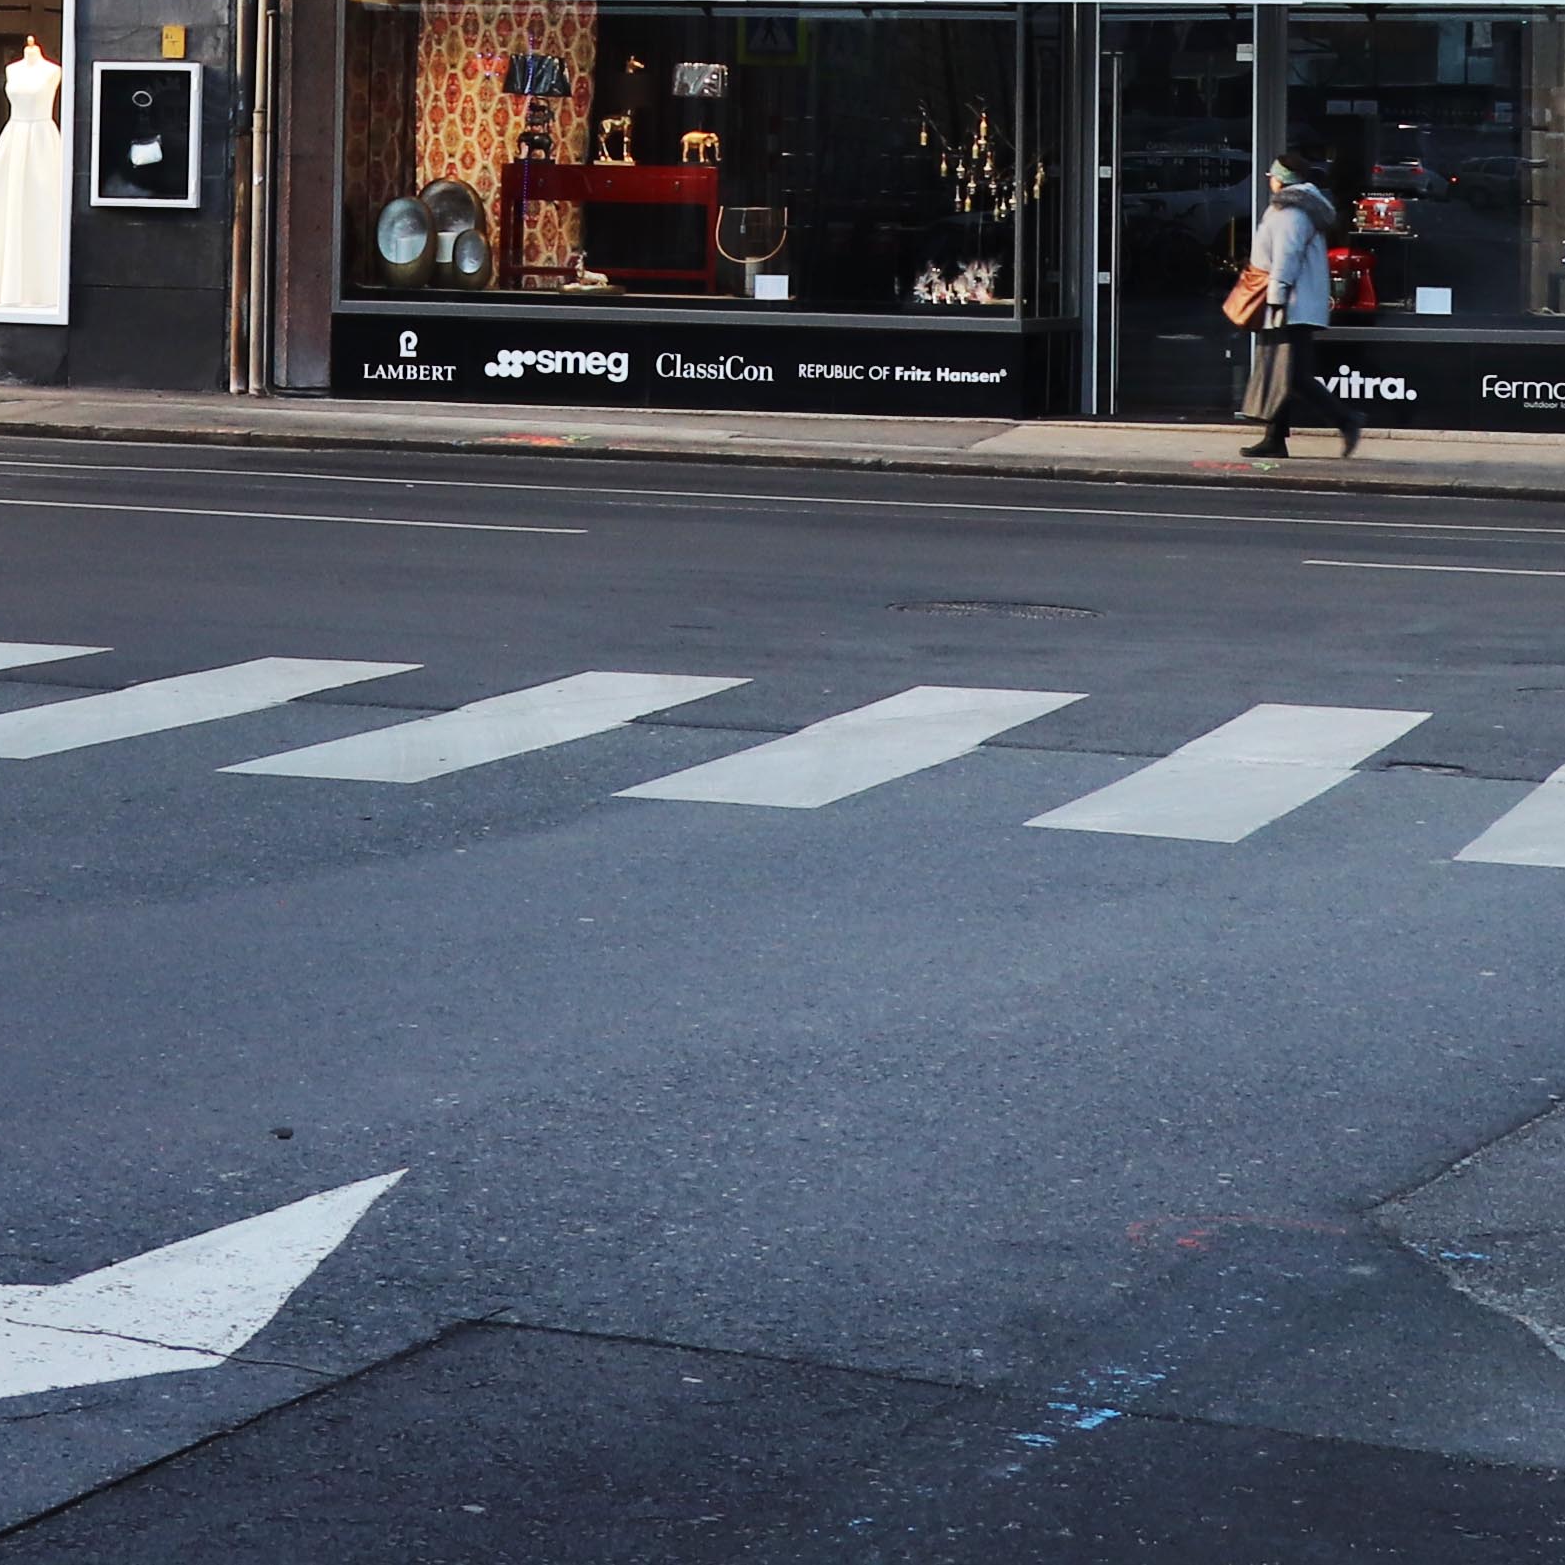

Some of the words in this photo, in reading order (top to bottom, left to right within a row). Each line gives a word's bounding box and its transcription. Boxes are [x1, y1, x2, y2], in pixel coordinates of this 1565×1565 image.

[364, 363, 457, 381] LAMBERT
[536, 349, 629, 383] smeg
[655, 352, 775, 382] ClassiCon
[798, 363, 864, 380] REPUBLIC
[868, 366, 890, 380] OF
[894, 365, 932, 382] Fritz
[1523, 401, 1558, 409] outdoor
